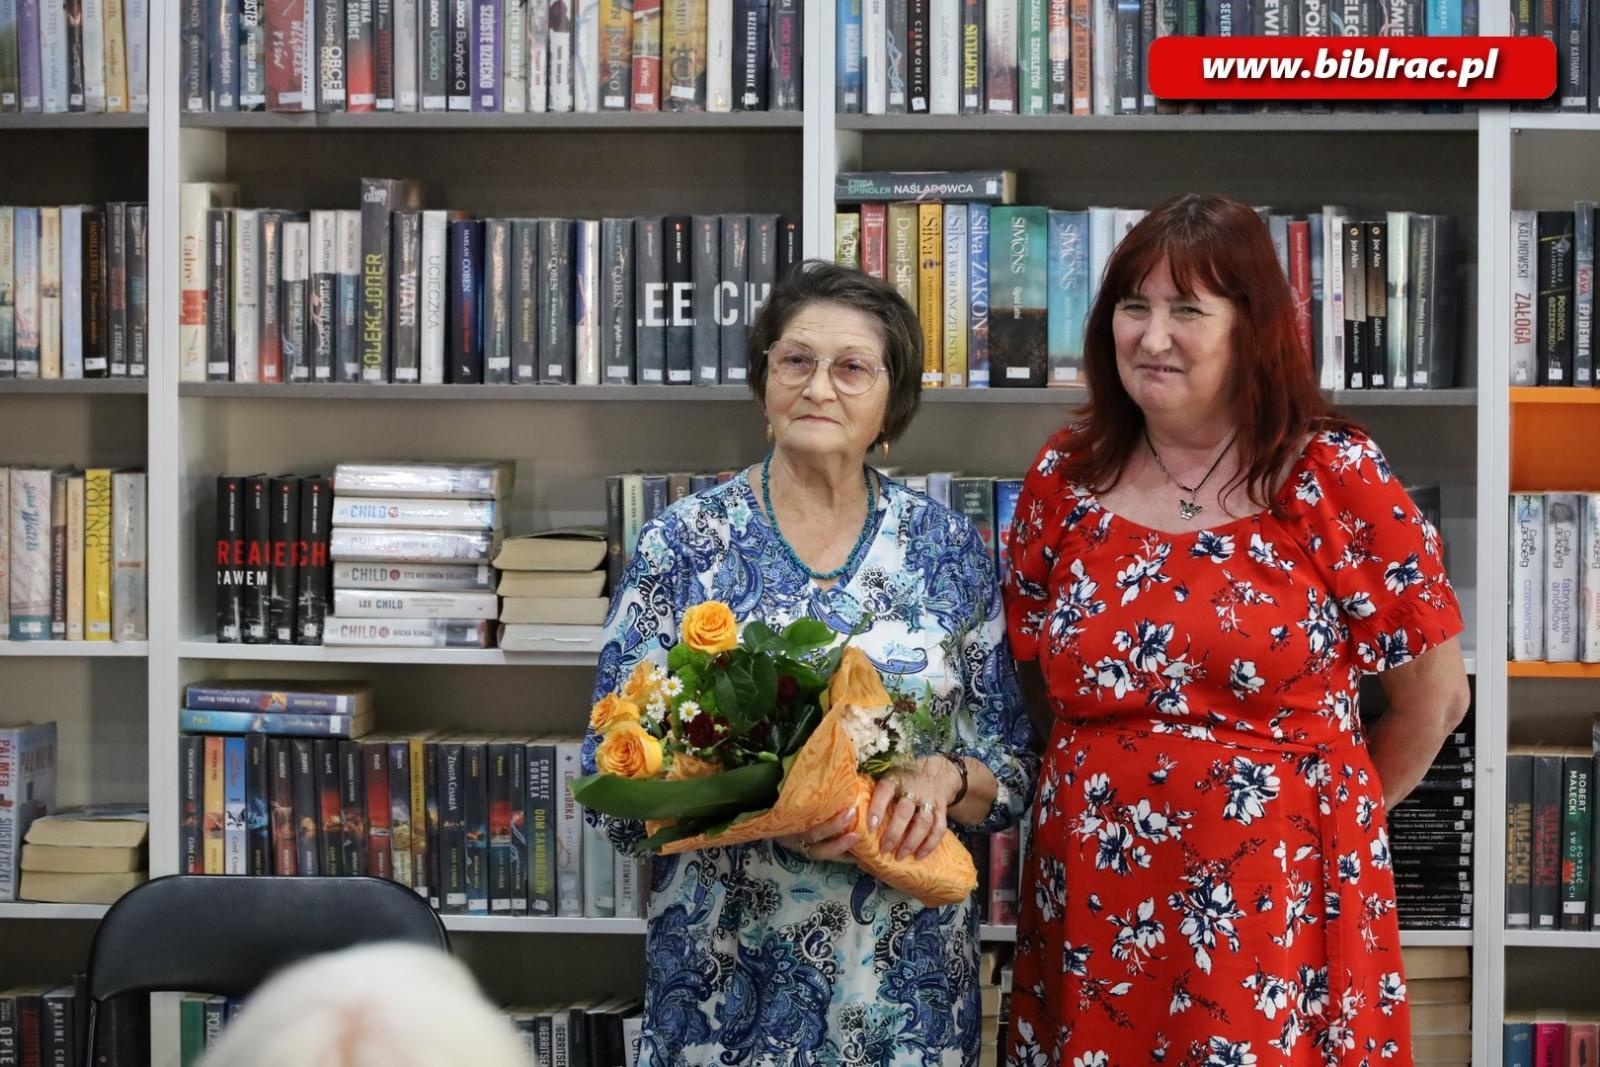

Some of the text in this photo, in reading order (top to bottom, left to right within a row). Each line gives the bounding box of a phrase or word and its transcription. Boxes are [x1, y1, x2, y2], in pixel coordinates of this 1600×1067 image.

[348, 2, 362, 40] SŁOŃCE
[1570, 30, 1580, 44] KOD
[220, 51, 231, 84] edgara
[321, 46, 329, 90] DZIECKO
[329, 46, 342, 90] OBCE
[453, 31, 466, 91] Budynek Q
[480, 5, 495, 88] SZÓSTE DZIECKO
[605, 27, 626, 91] INFERNO
[746, 12, 756, 88] GRZEGORZ BRUDNIK
[914, 20, 922, 93] CZERWONIEC
[1031, 37, 1042, 89] SZKIELETÓW
[894, 183, 974, 195] NAŚLADOWCA
[897, 218, 910, 261] Daniel
[922, 216, 940, 255] Silva
[1011, 216, 1025, 273] SIMONS
[1059, 223, 1078, 289] SIMONS
[1373, 238, 1381, 252] Joe
[243, 220, 252, 296] PHILIP CARTER
[462, 258, 470, 292] COBEN
[522, 256, 530, 291] COBEN
[549, 257, 558, 291] COBEN
[971, 215, 989, 330] Silva ZAKON
[400, 272, 415, 326] WIATR
[428, 255, 440, 329] UCIECZKA
[612, 266, 623, 308] COBEN
[948, 216, 965, 368] Silva WIOLONCZELISTKA
[1515, 222, 1531, 344] KALINOWSKI ZAŁOGA
[1557, 295, 1566, 341] POGROMCA
[1578, 303, 1590, 356] EPIDEMIA
[21, 509, 39, 551] Waters
[85, 475, 99, 548] YOUNG
[99, 475, 111, 564] SAMANTHA
[350, 505, 386, 519] CHILD
[351, 567, 387, 581] CHILD
[359, 600, 372, 608] LEE
[375, 599, 403, 610] CHILD
[1523, 579, 1533, 640] czarownica
[1552, 582, 1562, 631] aniołków
[1560, 578, 1572, 643] fabrykantka
[340, 625, 377, 638] CHILD
[530, 761, 539, 798] DONLEA
[540, 759, 549, 800] CHARLIE
[1569, 770, 1577, 815] MAŁECKI
[1578, 773, 1586, 812] ROBERT
[535, 809, 546, 829] DOM
[53, 1003, 64, 1043] MAXIME
